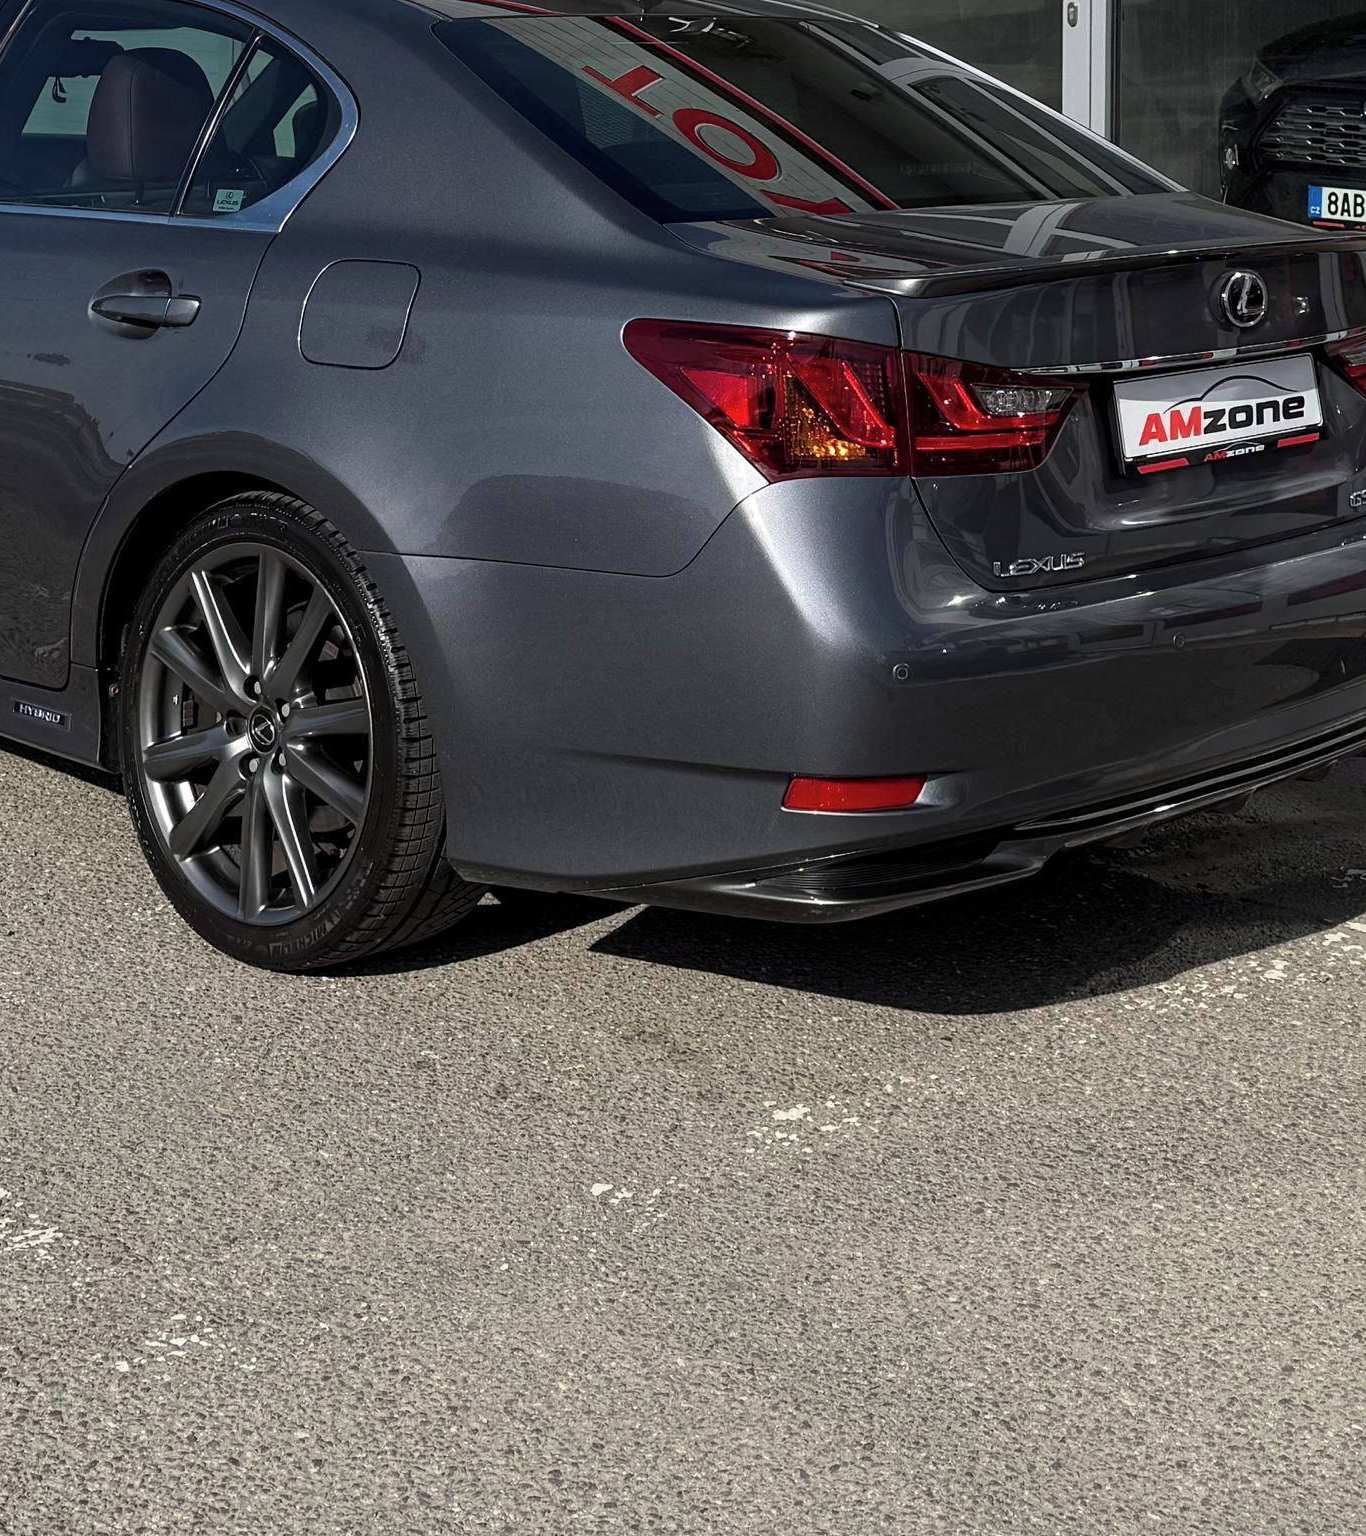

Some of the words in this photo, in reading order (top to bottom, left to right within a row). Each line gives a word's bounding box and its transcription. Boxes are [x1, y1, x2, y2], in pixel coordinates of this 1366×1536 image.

[1327, 191, 1366, 218] 8AB
[1138, 395, 1306, 447] AMzone
[1203, 443, 1266, 462] AMzone
[993, 551, 1085, 578] LEXUS
[19, 703, 61, 724] HYBRID
